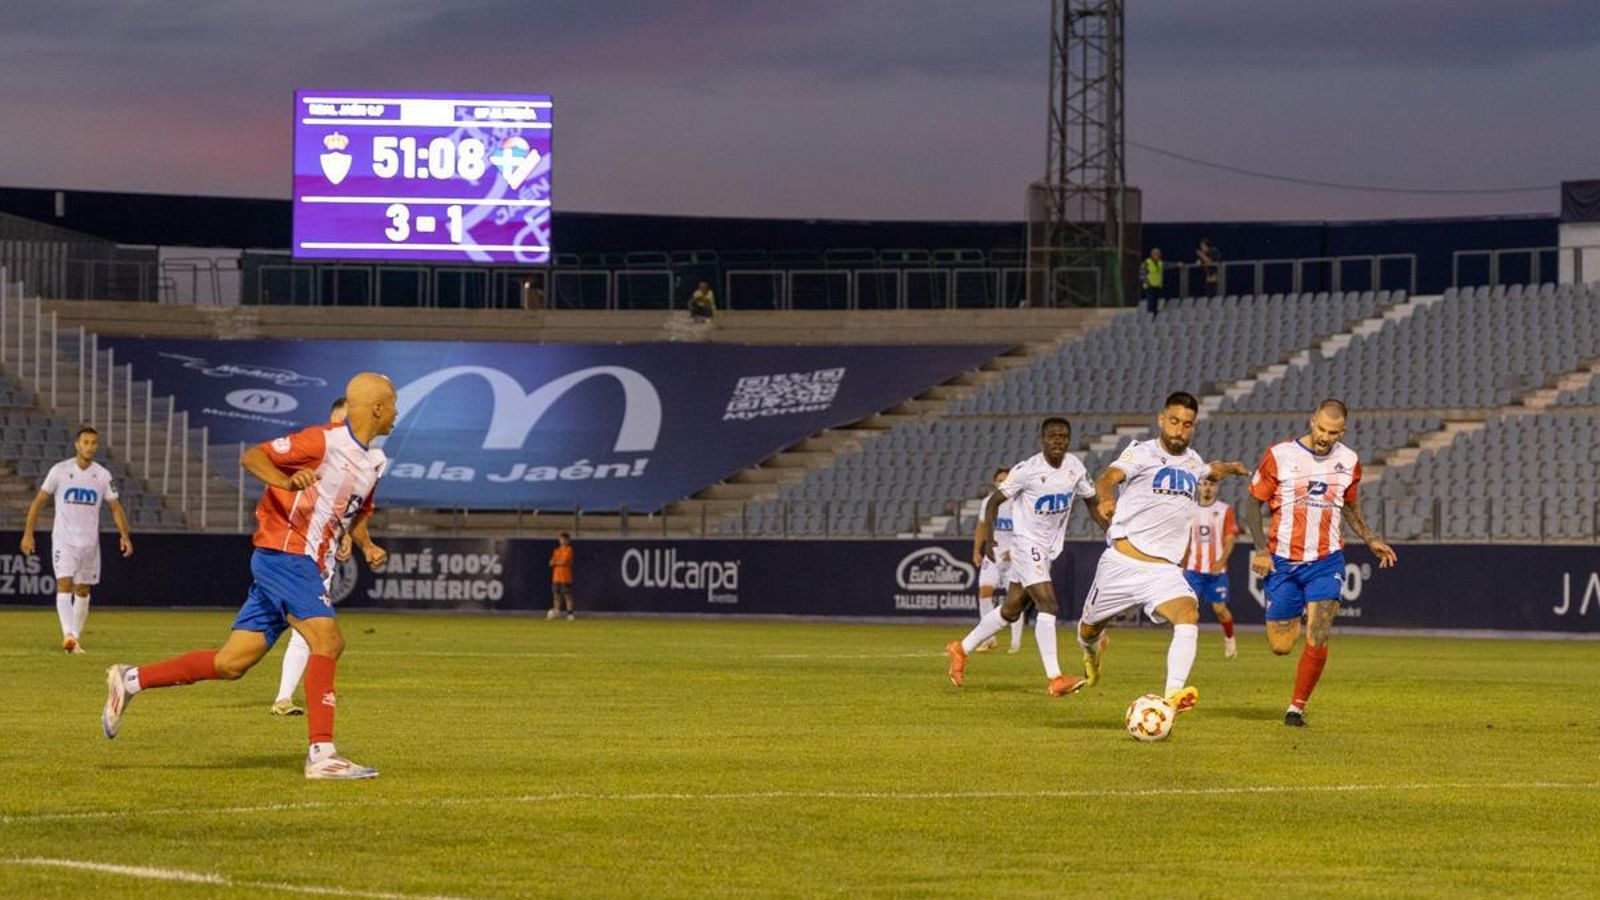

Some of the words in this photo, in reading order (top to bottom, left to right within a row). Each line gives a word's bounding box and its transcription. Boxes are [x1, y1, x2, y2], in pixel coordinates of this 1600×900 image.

[372, 135, 486, 180] 51:08
[384, 202, 411, 243] 3
[446, 204, 463, 244] 1
[722, 400, 831, 422] MyOrder
[486, 456, 651, 483] Jaén!
[437, 553, 503, 574] 100%
[1030, 546, 1041, 563] 5
[908, 560, 964, 584] EuroTaller
[367, 574, 504, 600] JAENÉRICO
[894, 594, 937, 609] TALLERES
[940, 592, 977, 610] CÁMARA
